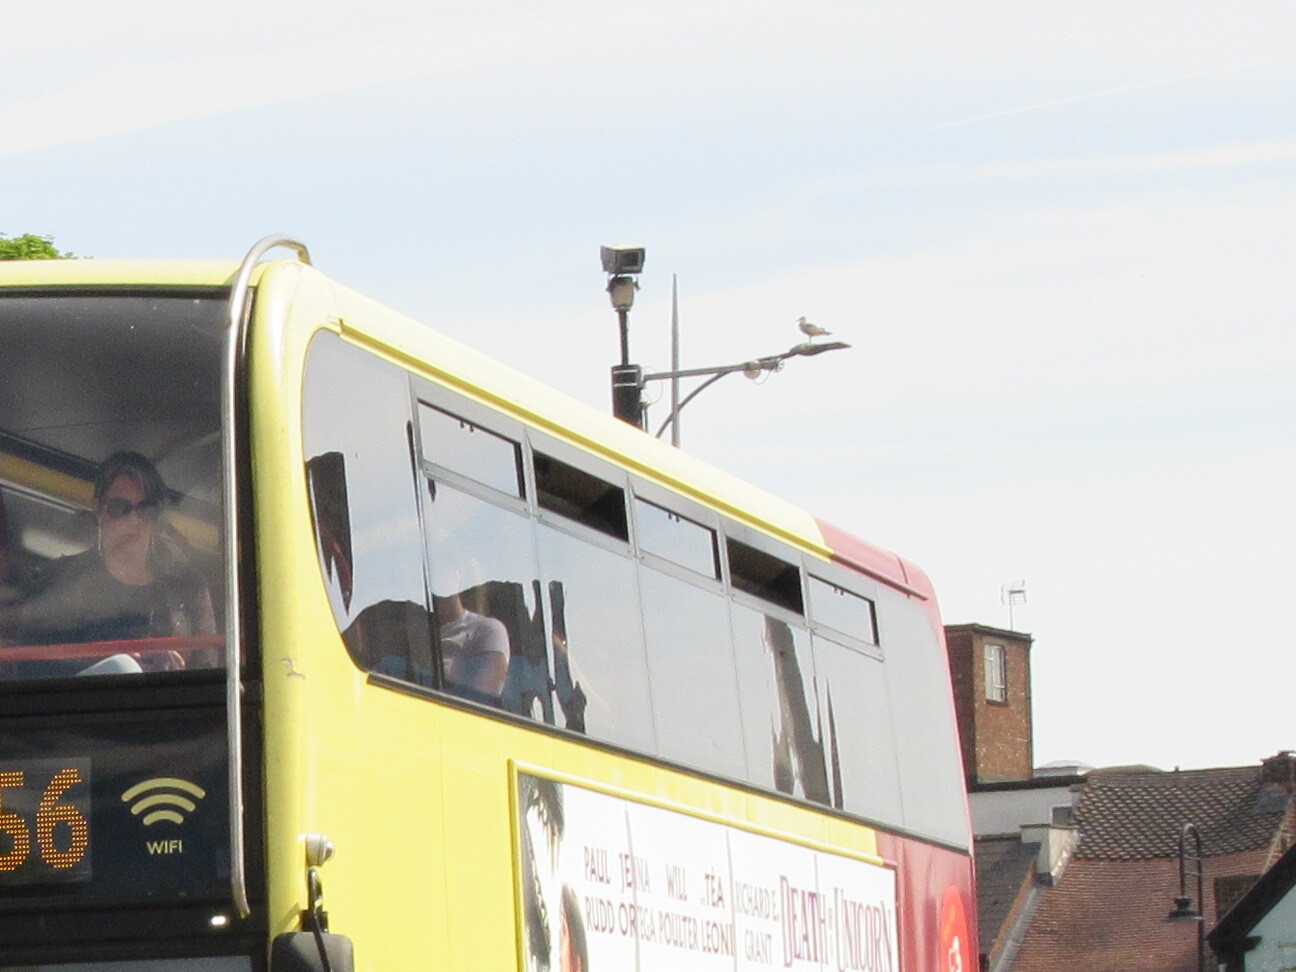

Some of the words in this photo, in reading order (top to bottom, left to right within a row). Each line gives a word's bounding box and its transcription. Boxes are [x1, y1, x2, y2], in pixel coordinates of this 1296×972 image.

[147, 839, 183, 855] WIFI
[584, 845, 611, 884] PAUL
[665, 864, 688, 901] WILL
[585, 896, 615, 934] RUDD
[658, 910, 700, 951] POULTER
[780, 874, 829, 968] DEATH
